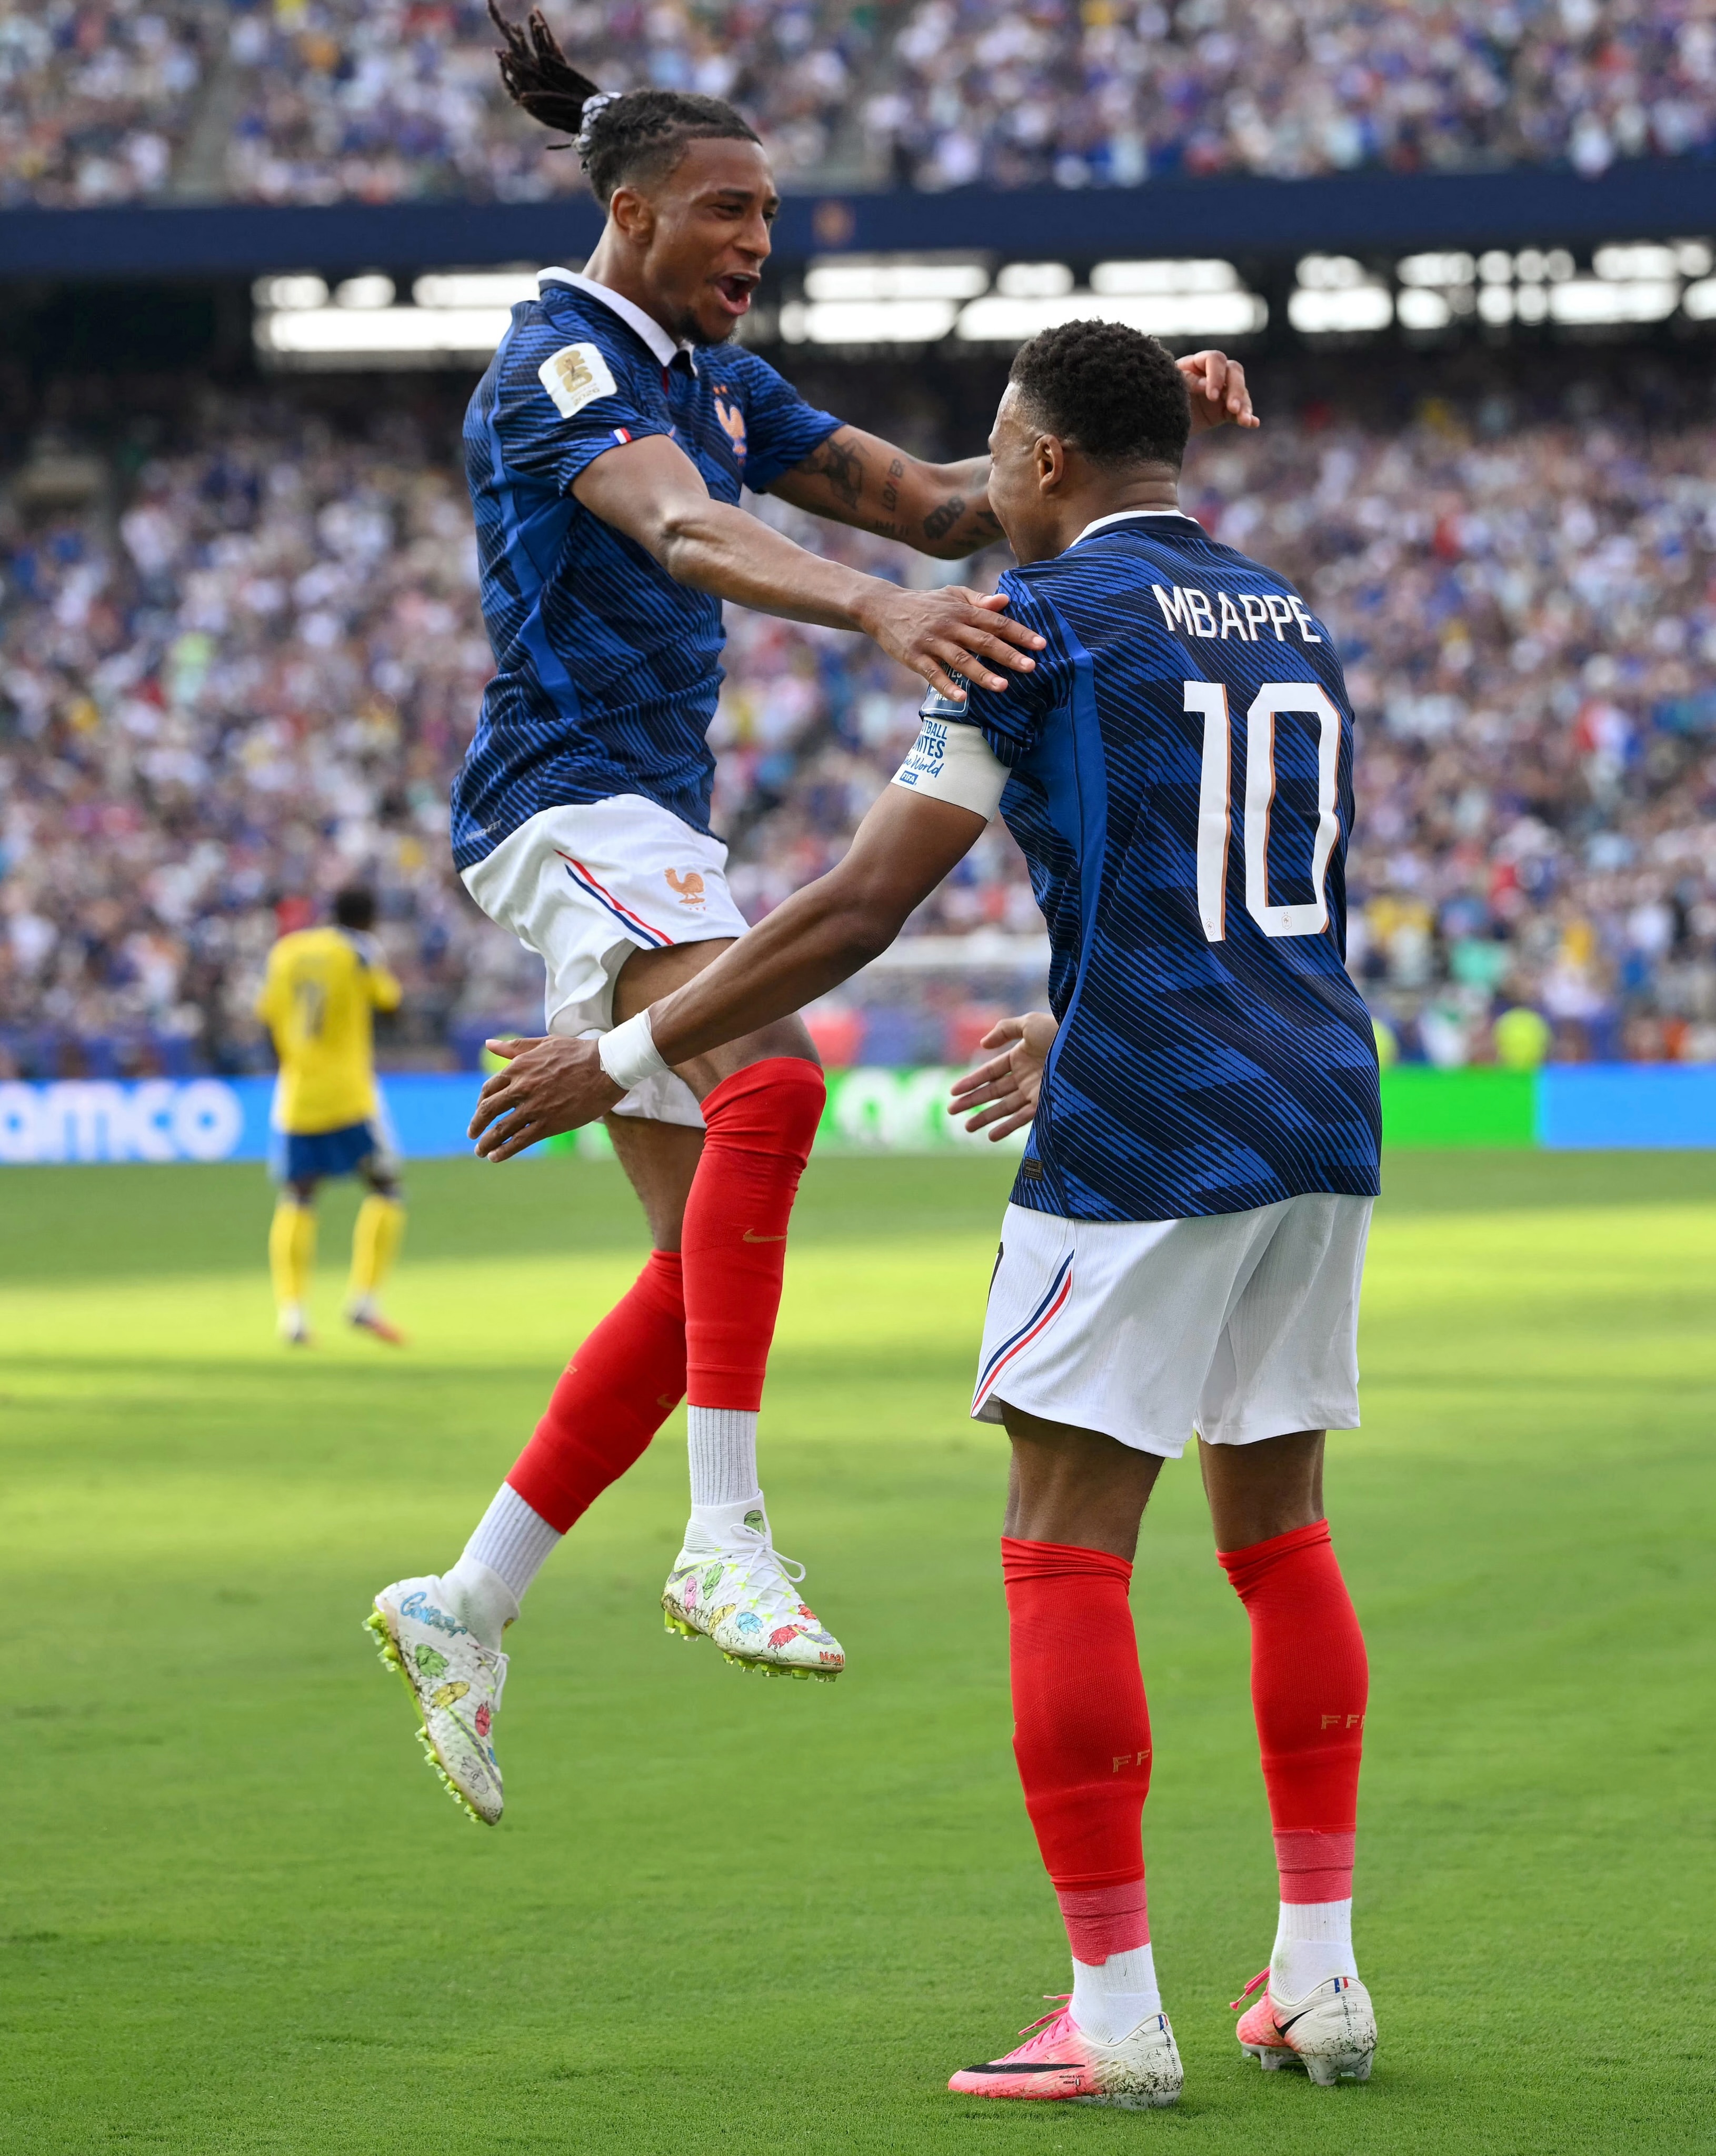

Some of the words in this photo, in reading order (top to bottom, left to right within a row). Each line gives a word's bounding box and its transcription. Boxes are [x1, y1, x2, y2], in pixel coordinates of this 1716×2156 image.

[1152, 584, 1322, 643] MBAPPE
[901, 772, 916, 783] FIFA
[911, 755, 944, 778] World
[1184, 681, 1341, 942] 10
[1341, 1995, 1353, 2038] SUPERFLY
